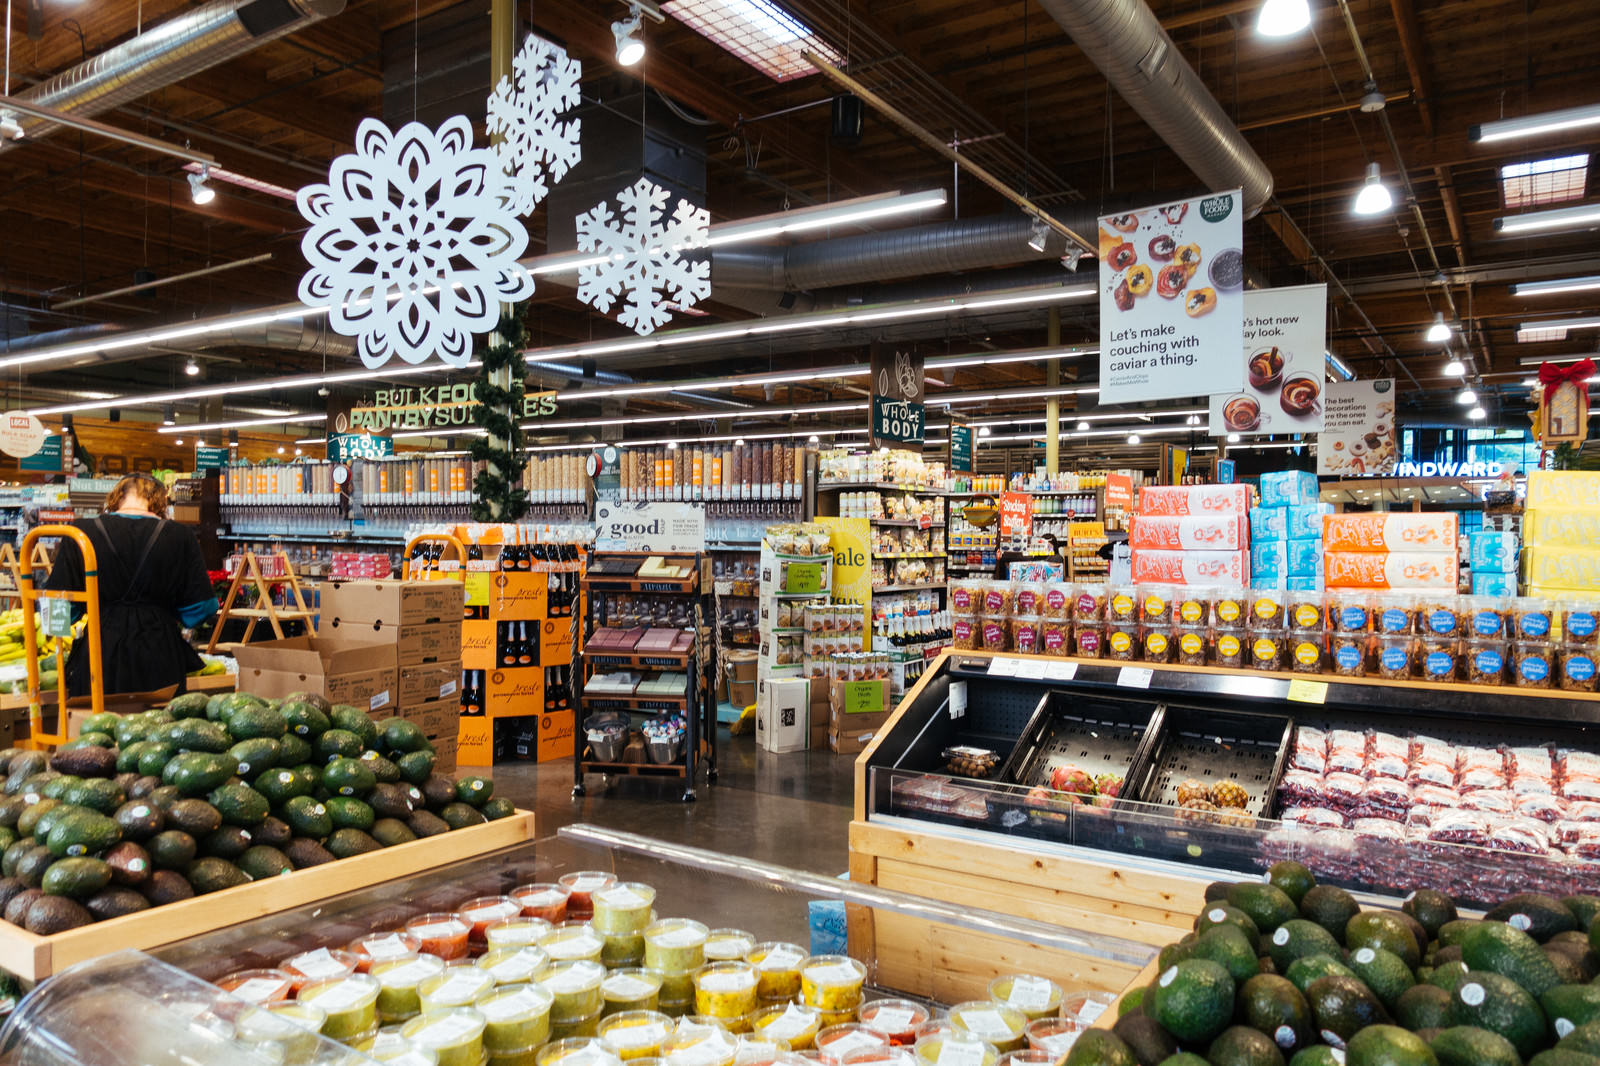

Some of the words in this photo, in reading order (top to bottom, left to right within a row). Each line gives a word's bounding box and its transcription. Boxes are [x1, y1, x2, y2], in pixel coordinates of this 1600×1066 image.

[1256, 316, 1273, 326] hot
[1276, 315, 1299, 325] new
[1110, 328, 1137, 342] Let's
[1140, 324, 1176, 338] make
[1258, 326, 1285, 337] look.
[1110, 340, 1167, 357] couching
[1170, 335, 1200, 349] with
[1110, 357, 1150, 372] caviar
[1150, 358, 1157, 367] a
[1160, 353, 1198, 367] thing.
[375, 387, 436, 409] BULK
[1339, 396, 1355, 404] best
[350, 407, 437, 429] PANTRY
[881, 402, 920, 423] WHOLE
[882, 418, 919, 439] BODY
[1352, 418, 1366, 426] eat.
[337, 437, 387, 451] WHOLE
[1003, 500, 1027, 516] Stocking
[610, 518, 660, 540] good
[705, 527, 728, 540] BULK
